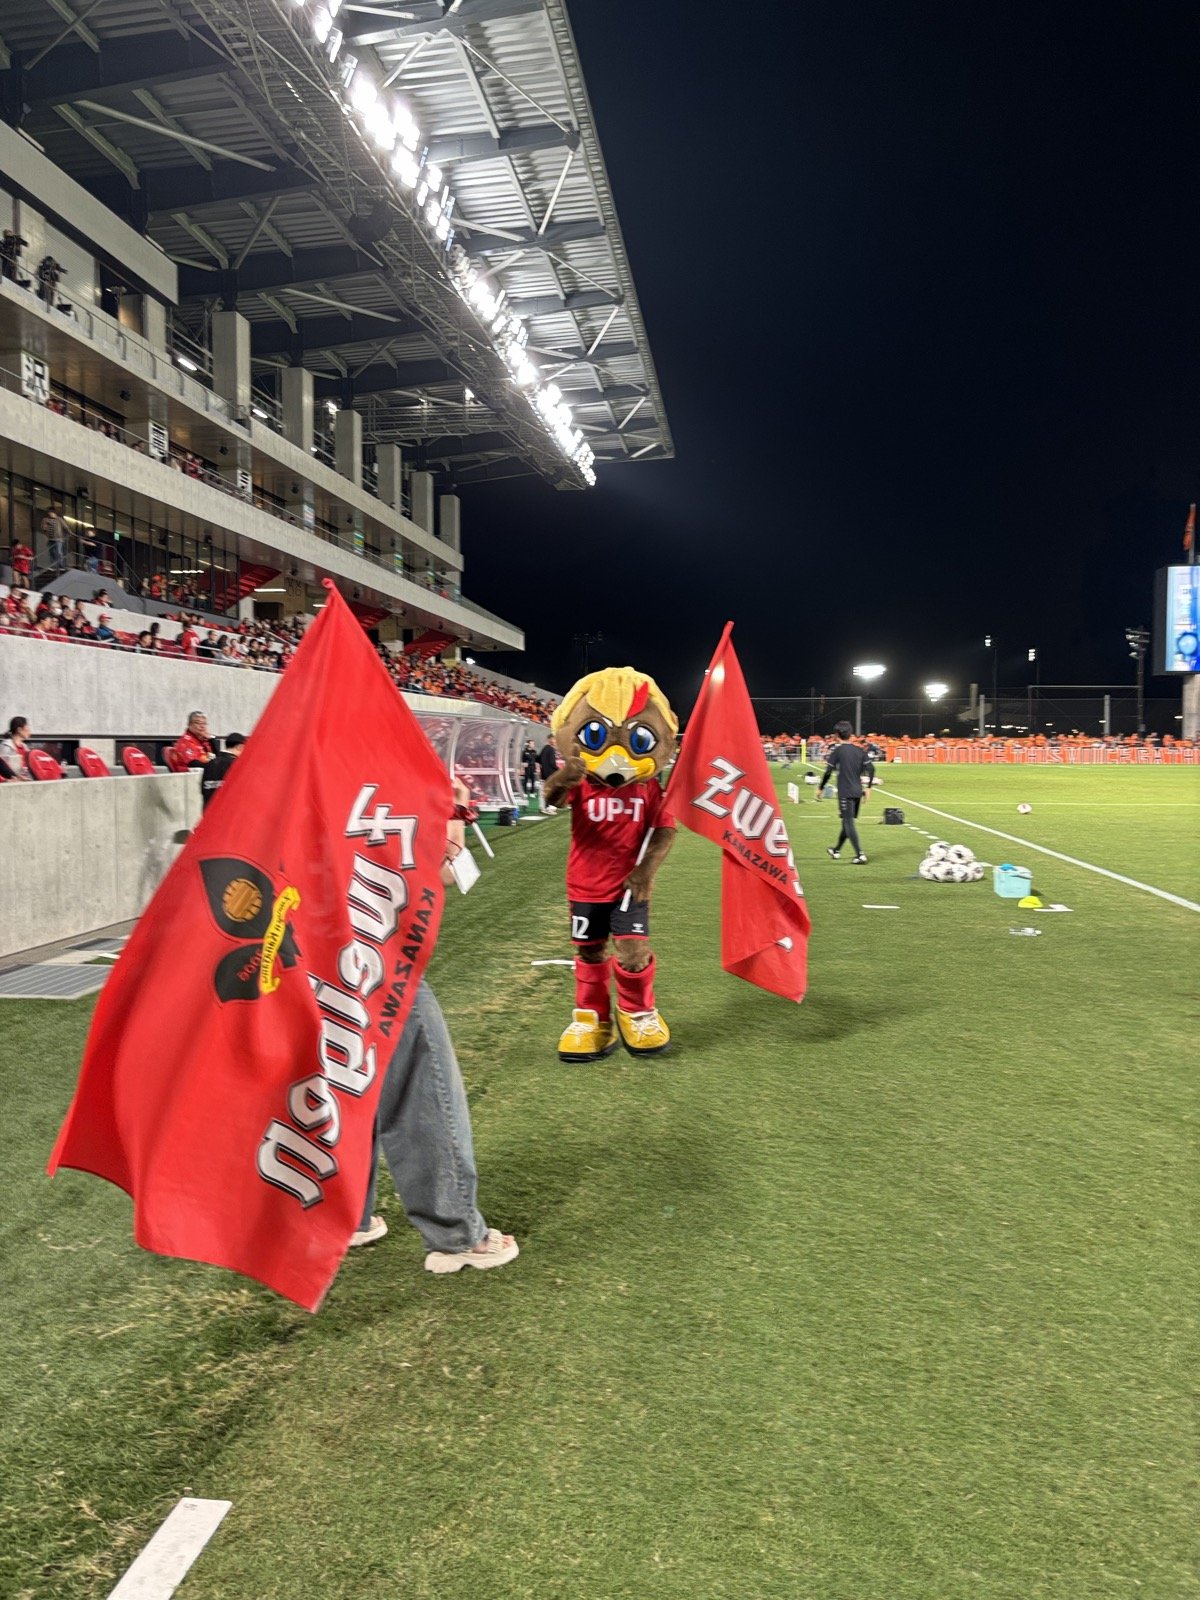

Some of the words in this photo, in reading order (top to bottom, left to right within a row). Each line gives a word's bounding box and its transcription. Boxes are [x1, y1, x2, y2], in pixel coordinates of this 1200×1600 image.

[587, 797, 644, 822] UP-T
[721, 830, 789, 885] KANAZAWA
[571, 915, 590, 939] 12
